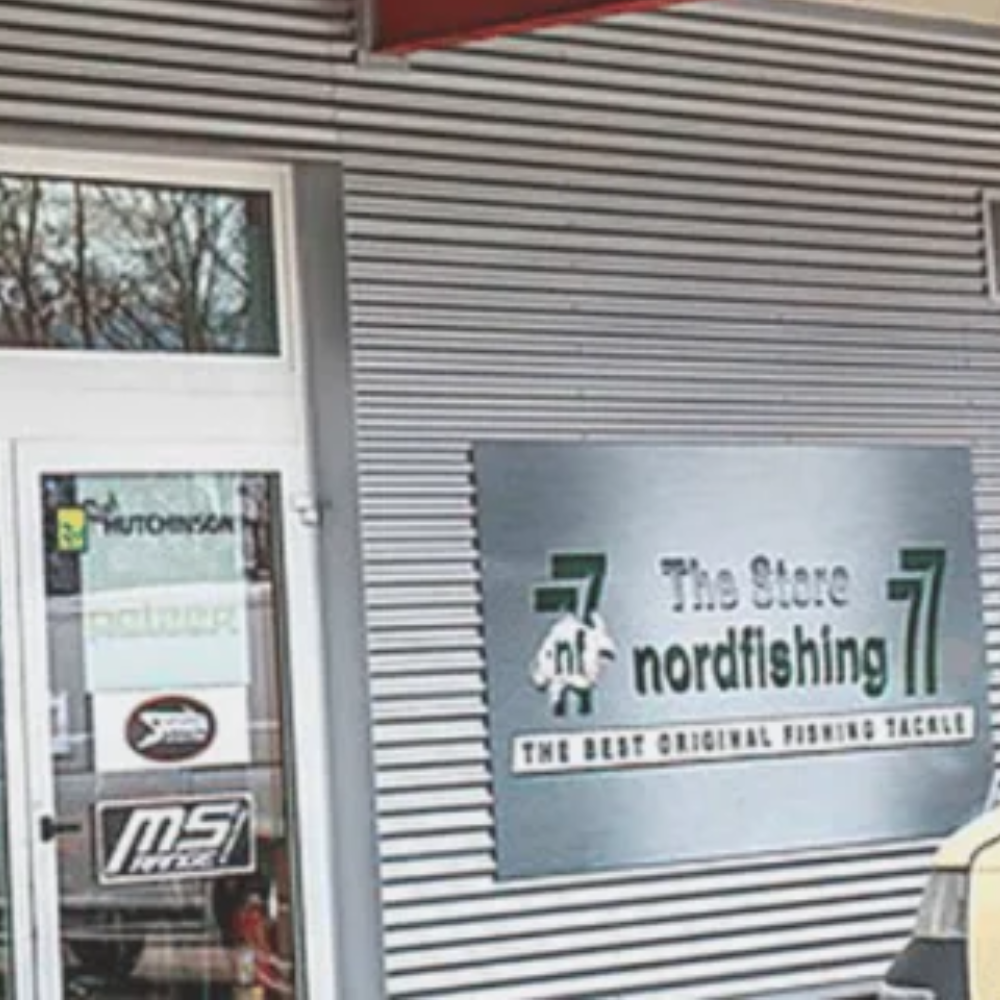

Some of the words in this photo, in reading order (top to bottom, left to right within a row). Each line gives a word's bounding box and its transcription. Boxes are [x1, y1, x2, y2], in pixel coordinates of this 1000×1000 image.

[659, 556, 740, 612] The
[750, 554, 850, 610] Store
[887, 548, 945, 696] 77
[633, 624, 888, 698] nordfishing
[520, 739, 570, 765] THE
[583, 734, 646, 762] BEST
[656, 726, 772, 756] ORIGINAL
[783, 718, 875, 747] FISHING
[885, 712, 966, 739] TACKLE
